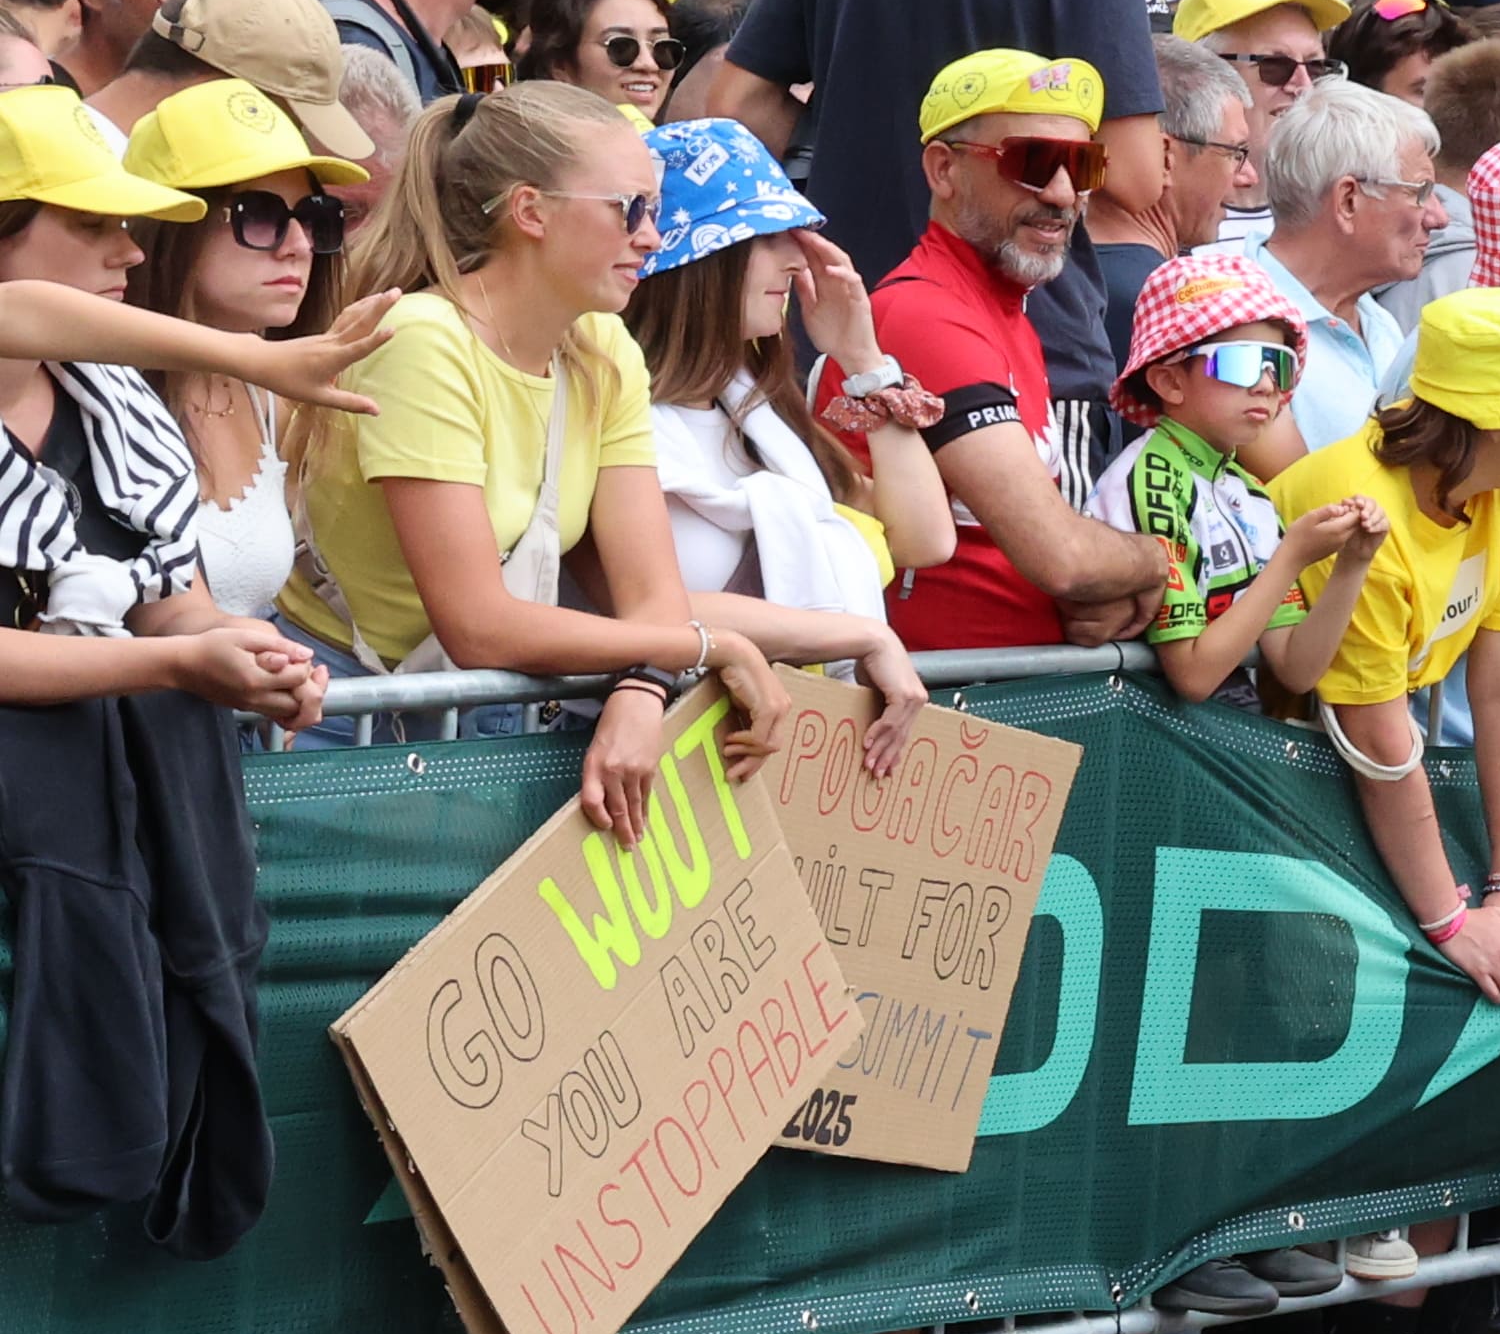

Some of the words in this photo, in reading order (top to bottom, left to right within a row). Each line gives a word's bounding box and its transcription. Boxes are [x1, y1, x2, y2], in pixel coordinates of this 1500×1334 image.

[693, 152, 721, 178] Krys
[780, 709, 1052, 883] POGAČAR
[427, 932, 546, 1109] GO
[538, 696, 752, 990] WOUT
[795, 843, 895, 948] UILT
[901, 877, 1012, 990] FOR
[521, 1029, 643, 1198] YOU
[659, 878, 777, 1058] ARE
[781, 1087, 858, 1147] 2025
